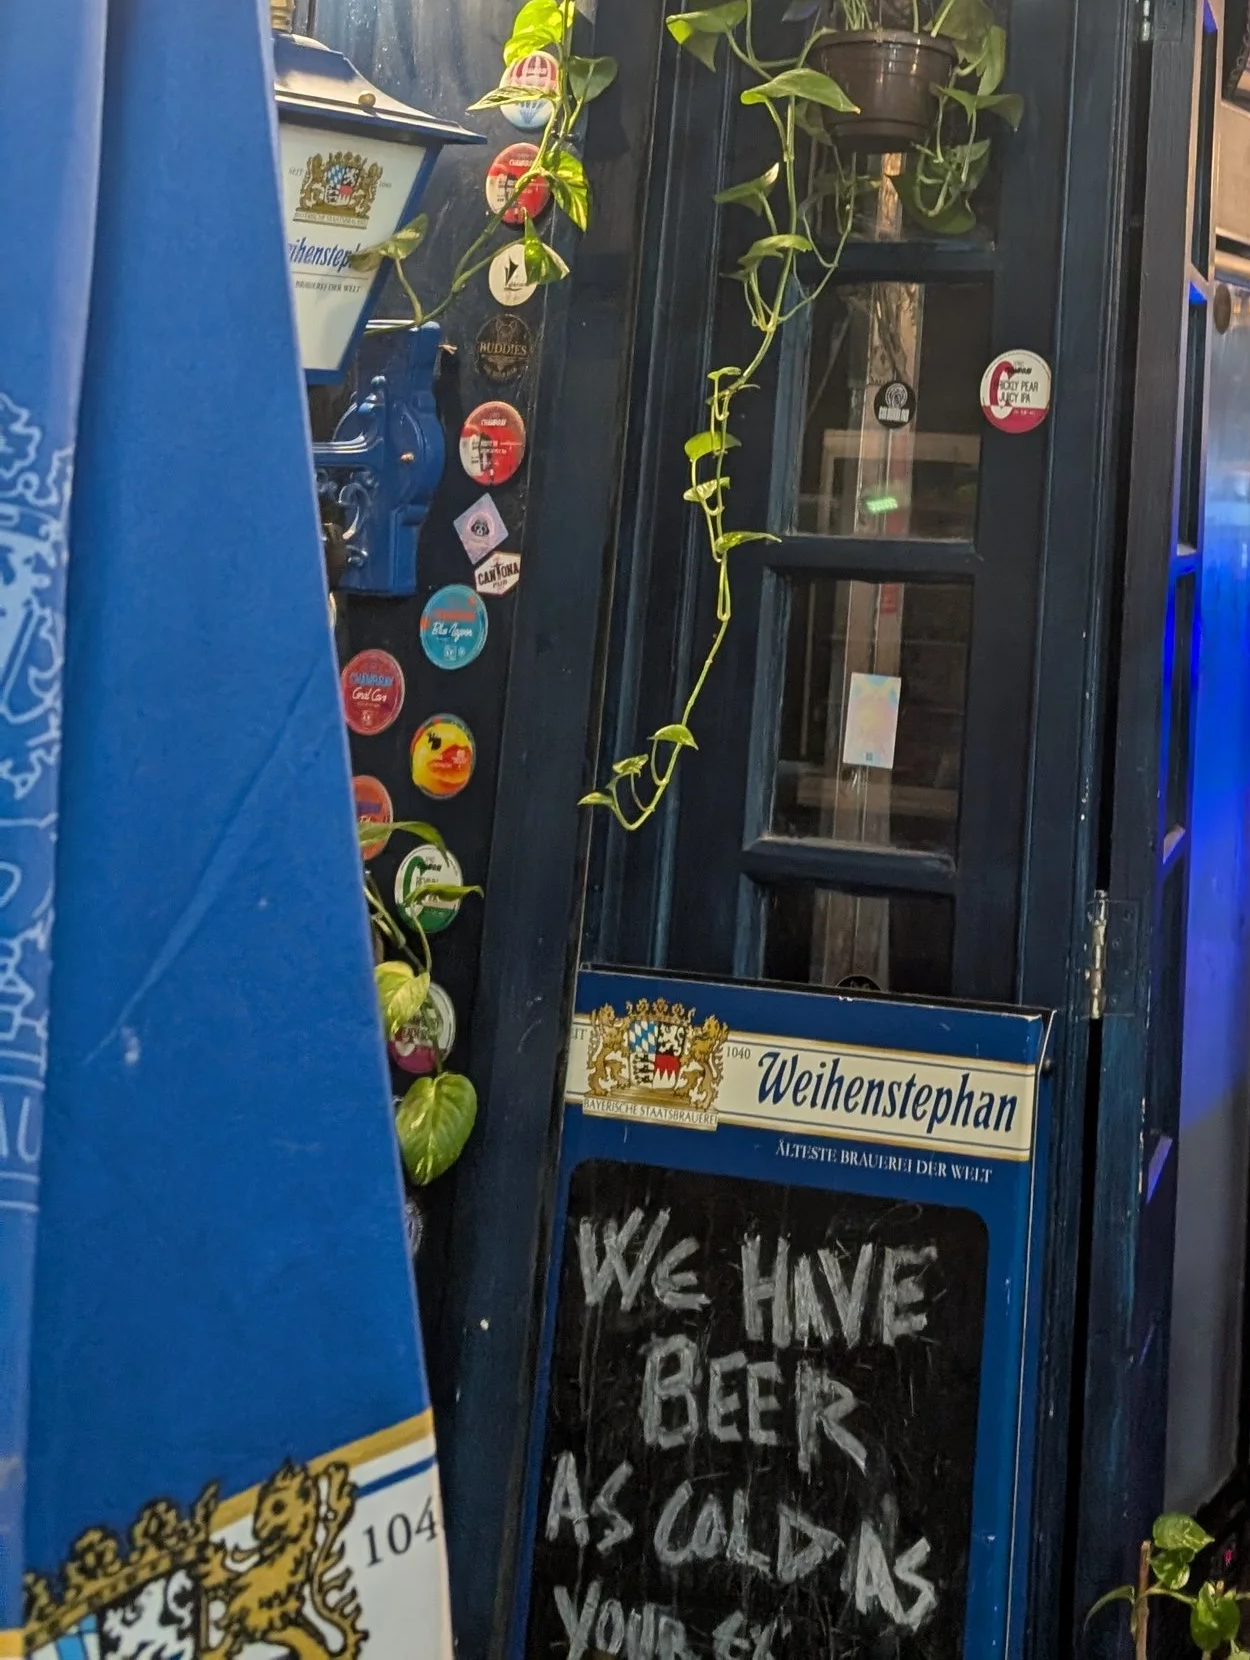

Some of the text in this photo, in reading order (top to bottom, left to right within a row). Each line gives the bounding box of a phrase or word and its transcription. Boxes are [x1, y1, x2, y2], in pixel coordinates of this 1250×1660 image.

[289, 237, 361, 273] ihenstep
[479, 341, 528, 356] BUDDIES
[998, 379, 1040, 393] RICKLY PEAR
[1020, 392, 1032, 404] IPA
[477, 561, 520, 586] CANTONA
[493, 579, 508, 589] PUB
[726, 1045, 751, 1060] 1040
[757, 1050, 1018, 1135] Weihenstephan
[583, 1098, 718, 1126] BAYERISCHE STAATSBRAUEREI
[775, 1139, 993, 1184] ÄLTESTE BRAUEREI DER WELT
[576, 1206, 939, 1350] WE HAVE
[640, 1332, 868, 1472] BEER
[545, 1449, 635, 1555] AS
[852, 1516, 940, 1632] AS
[553, 1580, 700, 1660] YOUR
